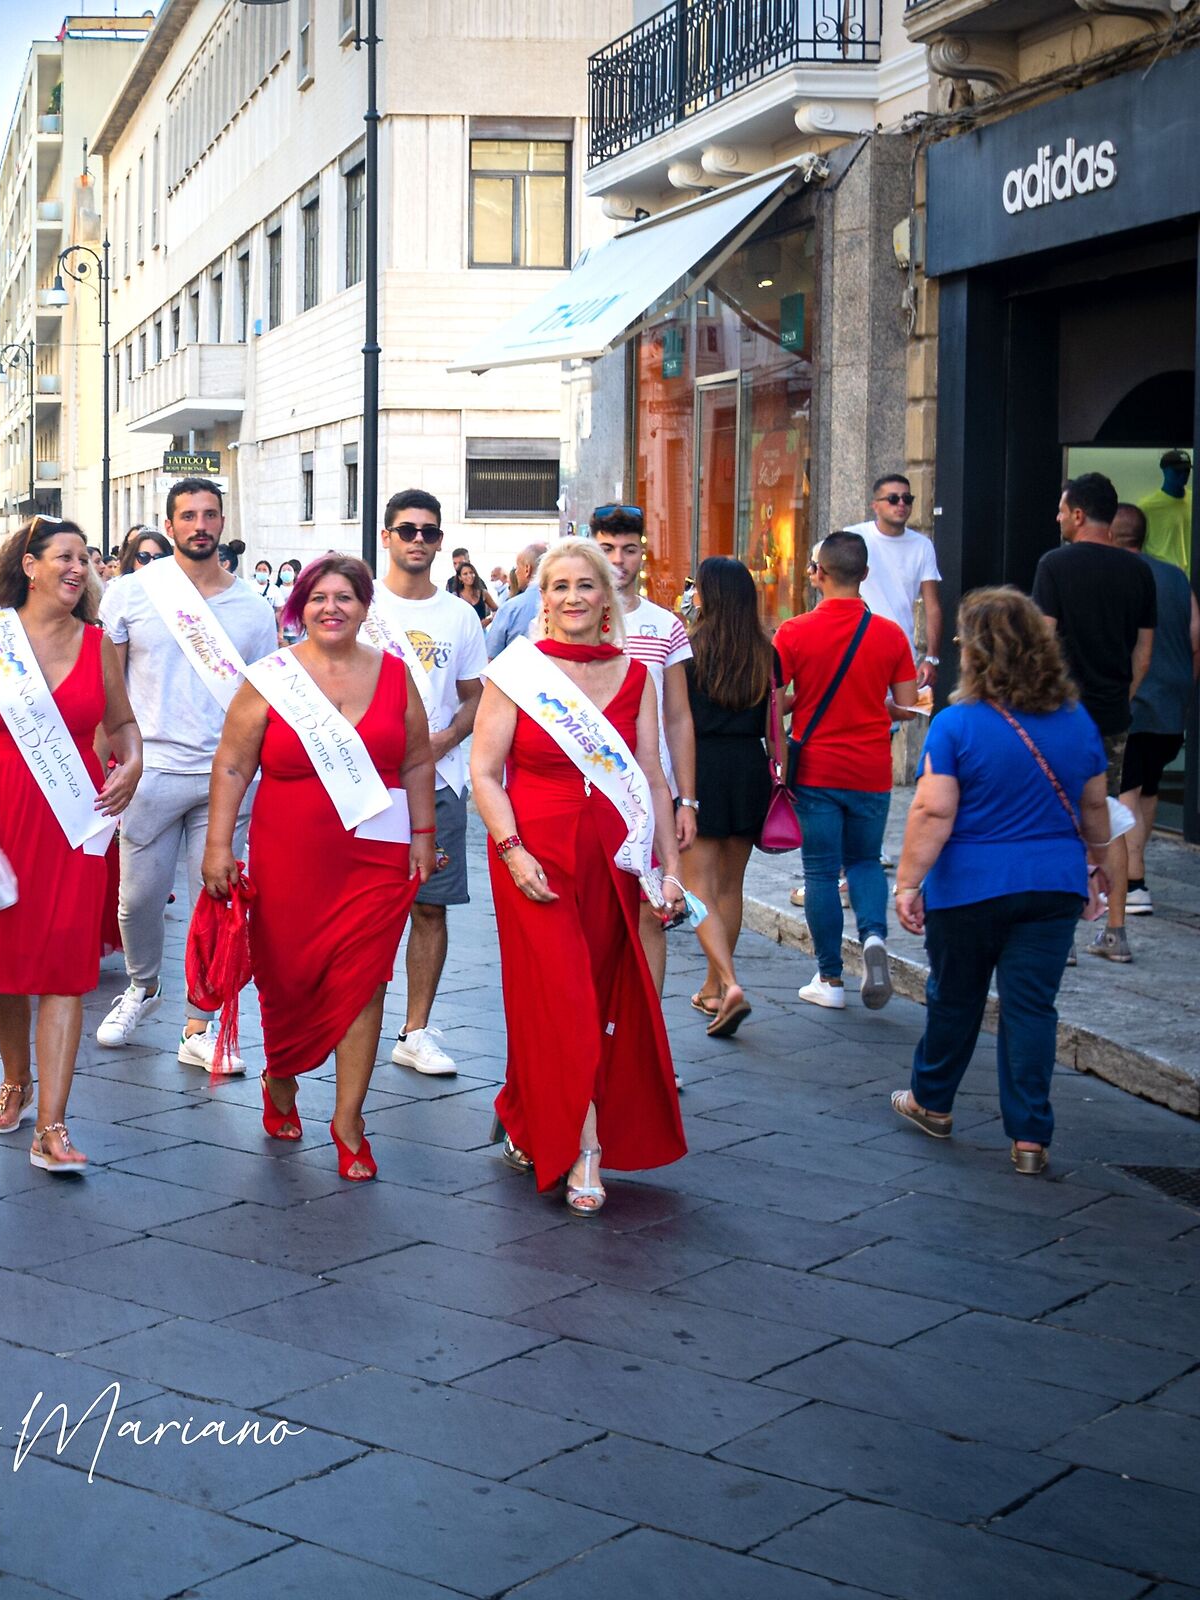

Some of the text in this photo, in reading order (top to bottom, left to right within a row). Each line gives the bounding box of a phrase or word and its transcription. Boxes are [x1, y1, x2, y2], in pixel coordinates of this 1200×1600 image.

[1002, 137, 1116, 214] adidas
[167, 456, 204, 465] TATTOO
[186, 627, 211, 665] Mister
[7, 706, 58, 790] sulle Donne
[15, 676, 81, 799] No alla Violenza
[282, 673, 306, 698] No
[321, 714, 362, 785] Violenza
[295, 713, 335, 773] Donne
[555, 714, 598, 754] Miss
[620, 771, 642, 805] No
